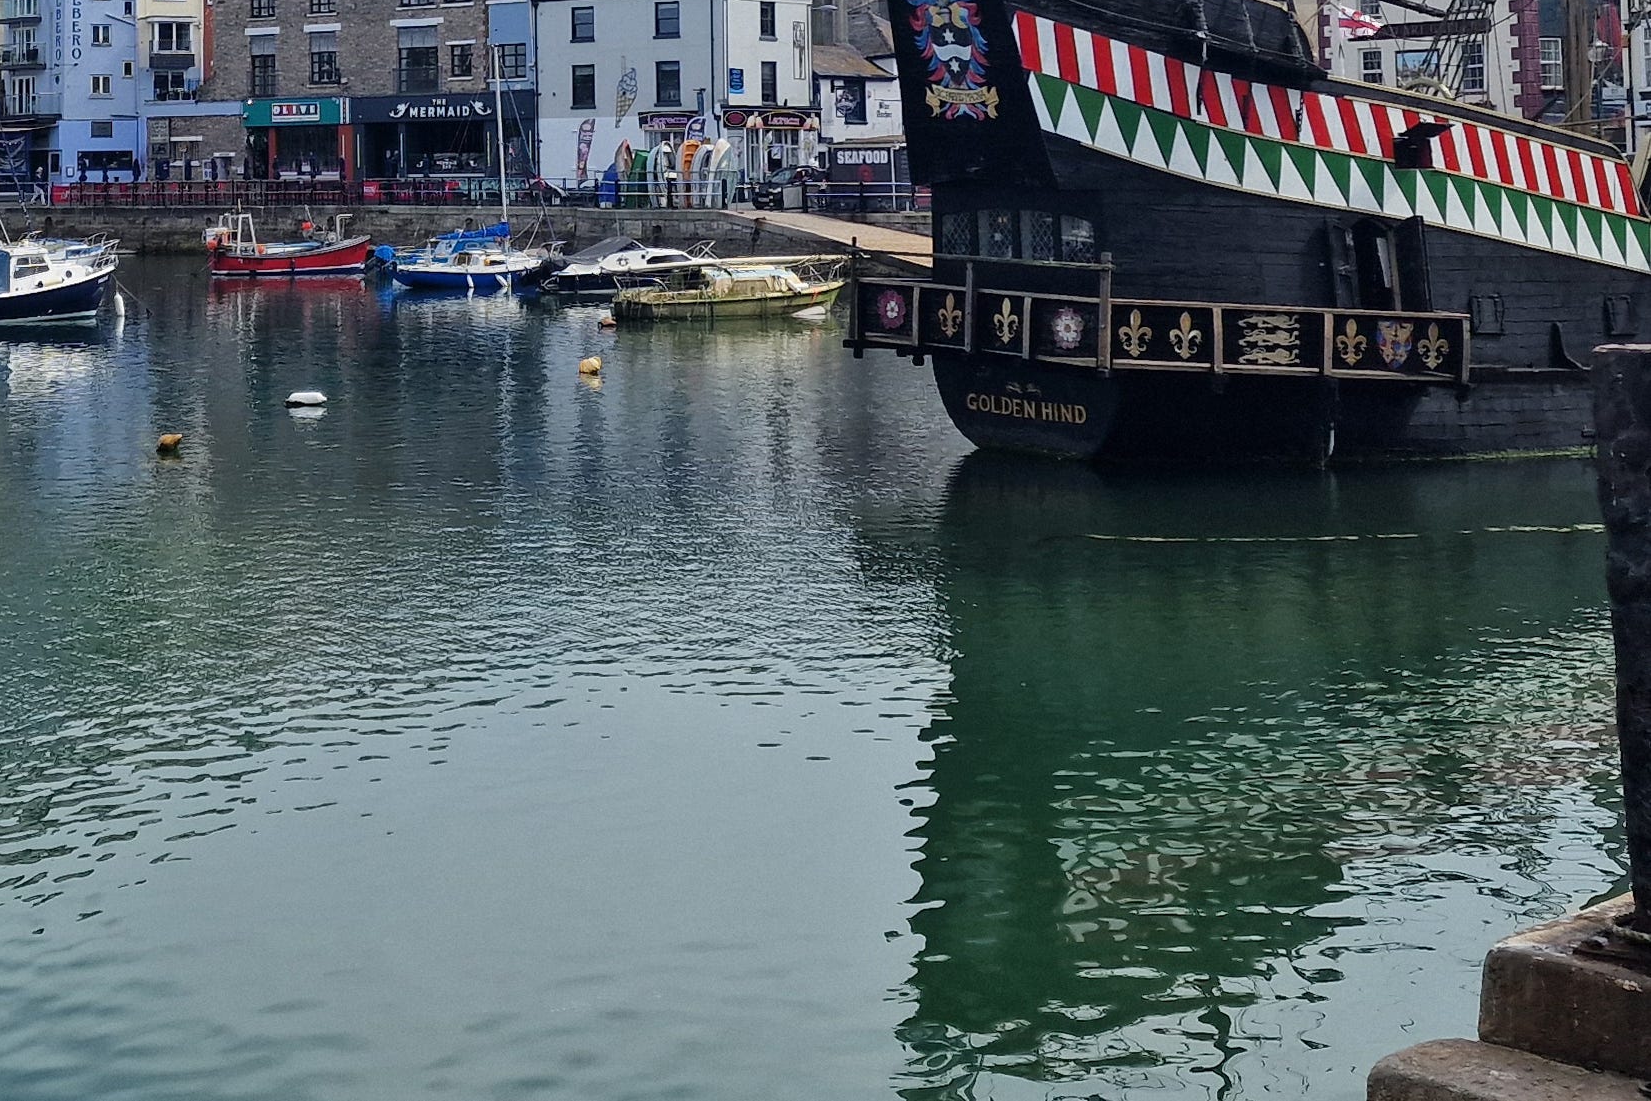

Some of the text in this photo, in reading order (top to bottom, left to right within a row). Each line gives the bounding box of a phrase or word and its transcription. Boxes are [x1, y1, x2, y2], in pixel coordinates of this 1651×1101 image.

[432, 98, 447, 106] THE
[273, 104, 316, 116] OLIVE
[409, 105, 470, 118] MERMAID
[836, 150, 889, 165] SEAFOOD
[966, 393, 1087, 424] GOLDEN HIND
